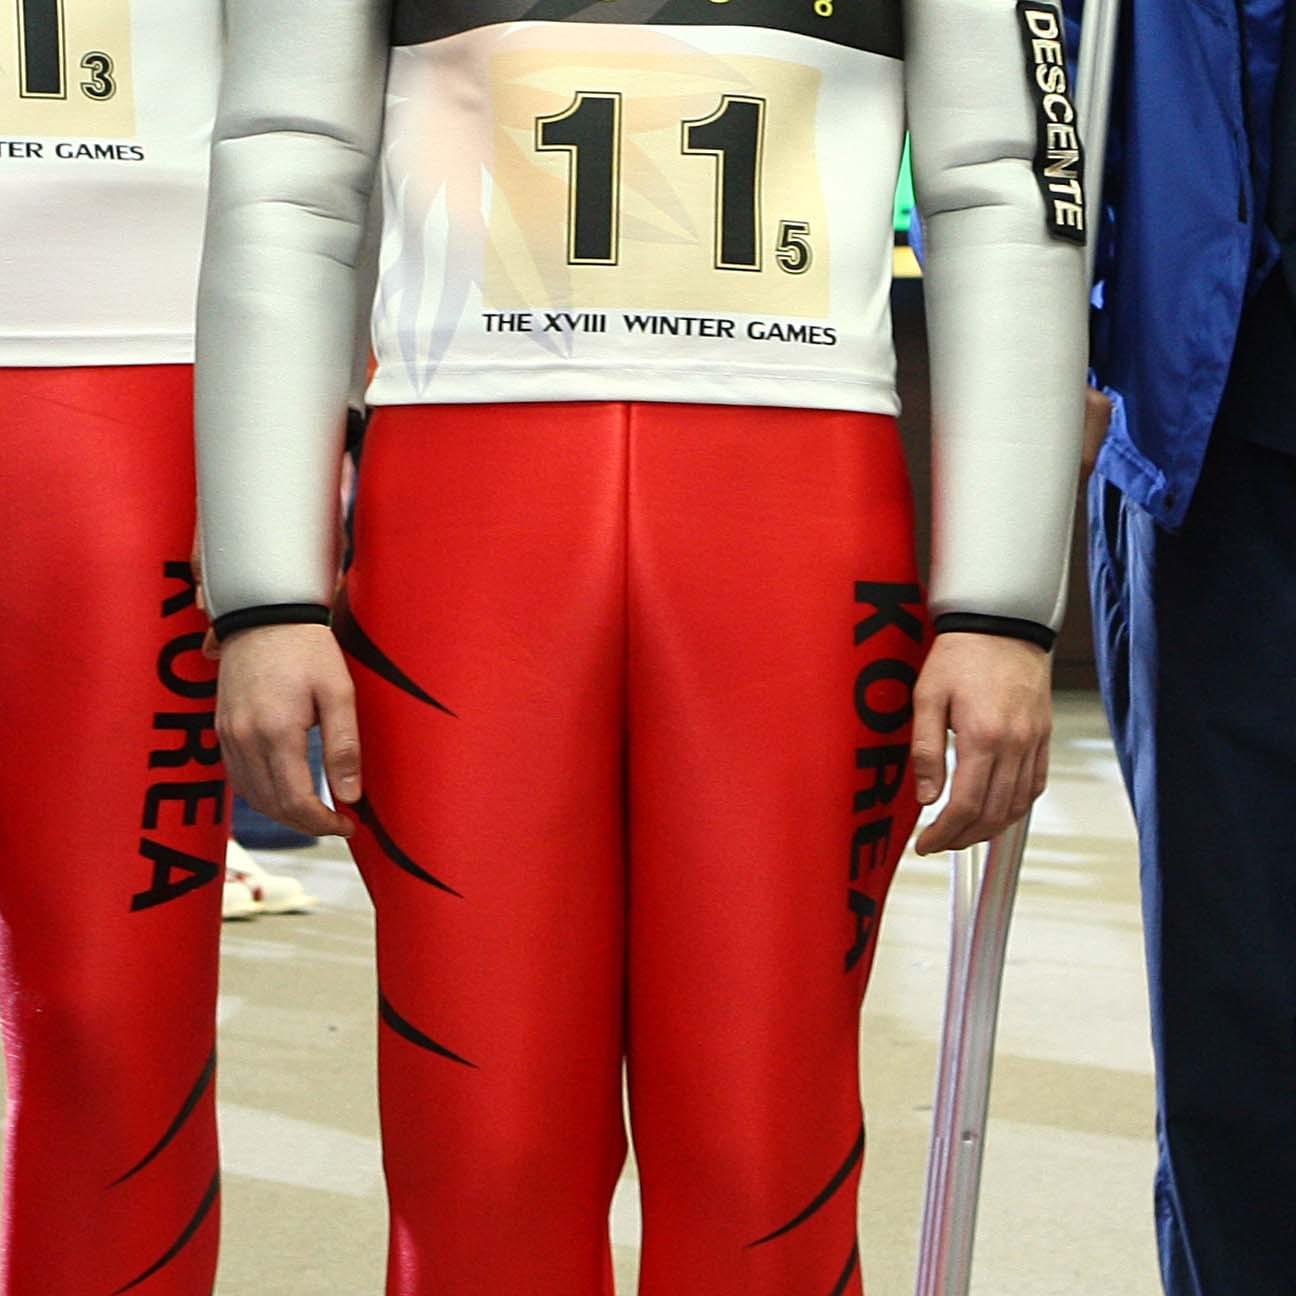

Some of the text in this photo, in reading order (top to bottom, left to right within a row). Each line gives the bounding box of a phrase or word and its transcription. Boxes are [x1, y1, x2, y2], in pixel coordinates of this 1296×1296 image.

[80, 51, 115, 102] 3
[1025, 10, 1084, 230] DESCENTE
[55, 141, 145, 163] GAMES
[534, 90, 811, 276] 11 5
[482, 312, 837, 347] THE XVIII WINTER GAMES
[846, 581, 922, 972] KOREA
